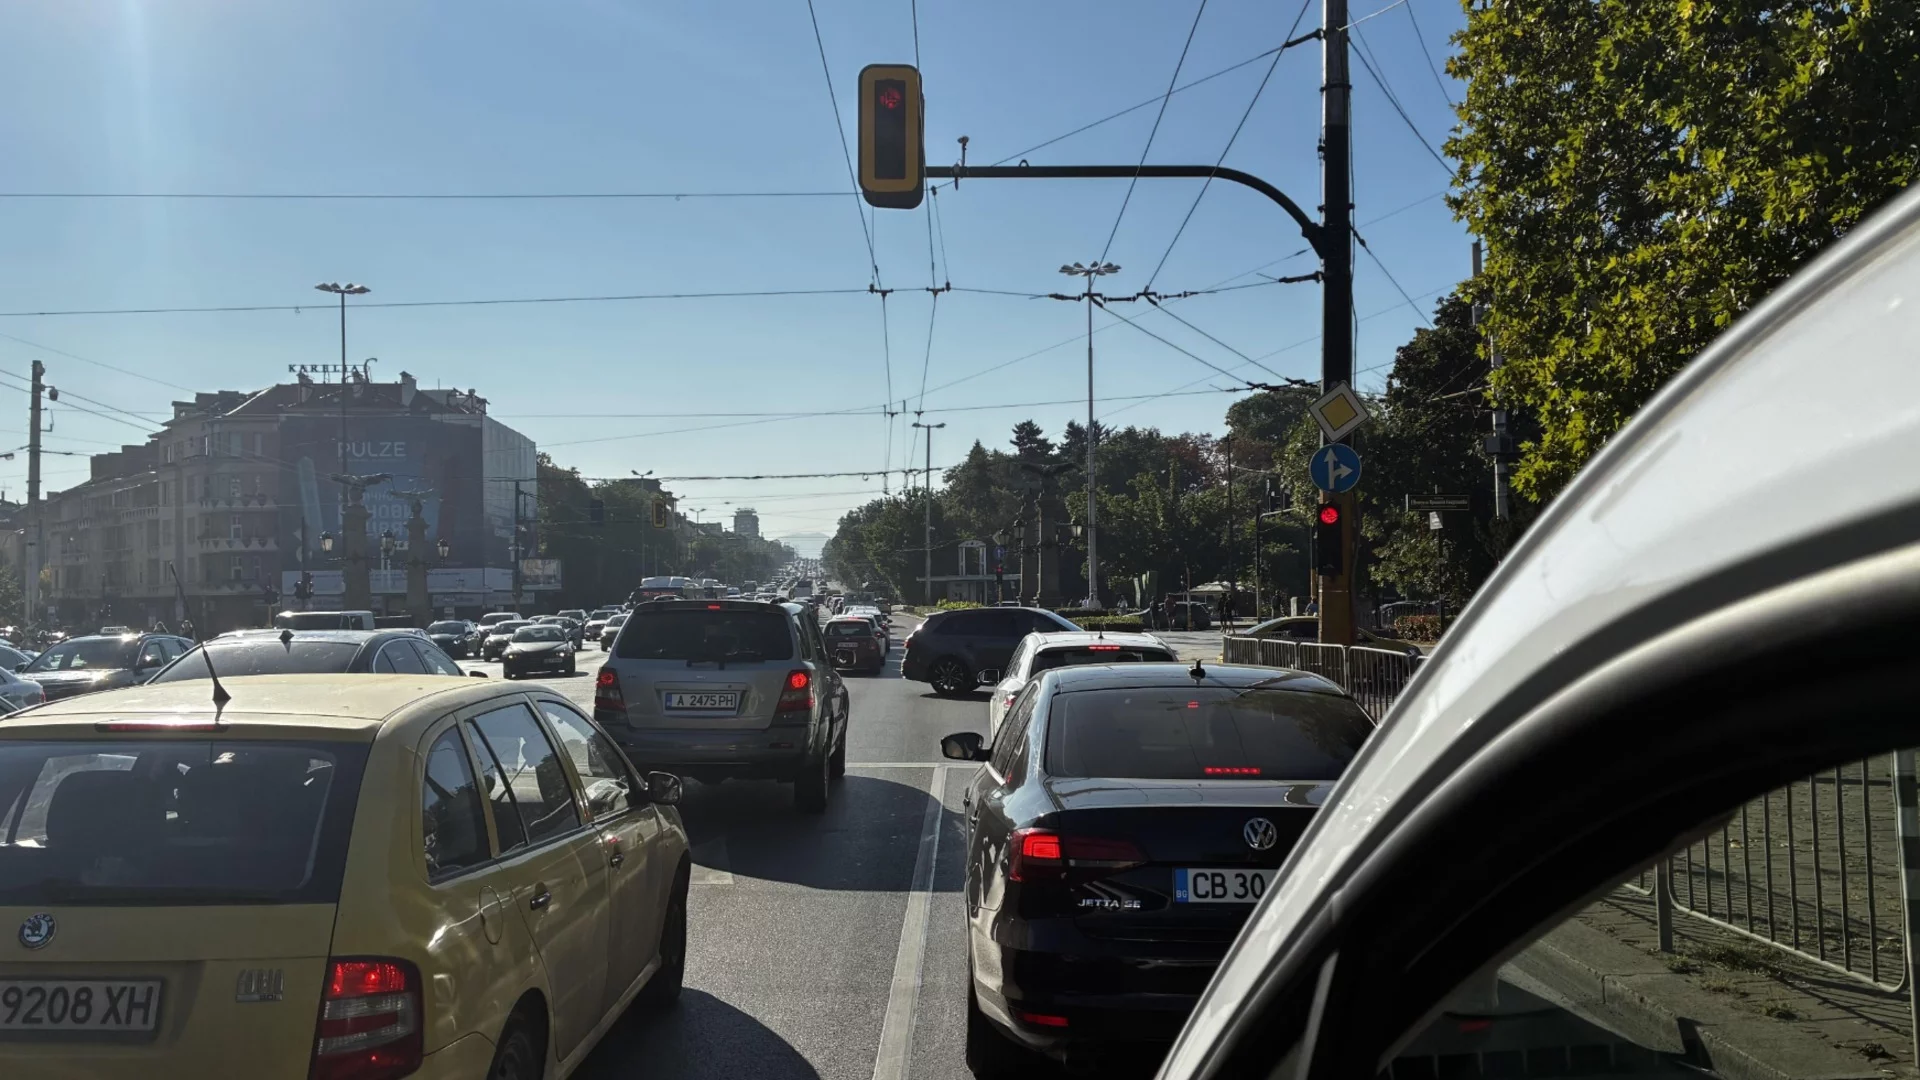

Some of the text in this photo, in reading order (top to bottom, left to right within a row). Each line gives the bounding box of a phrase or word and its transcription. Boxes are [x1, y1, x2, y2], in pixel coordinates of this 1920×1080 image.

[338, 441, 407, 457] PULZE
[1192, 872, 1228, 899] CB
[1176, 890, 1188, 898] BG
[1077, 898, 1141, 908] JETTA SE
[2, 986, 154, 1025] 9208 XH
